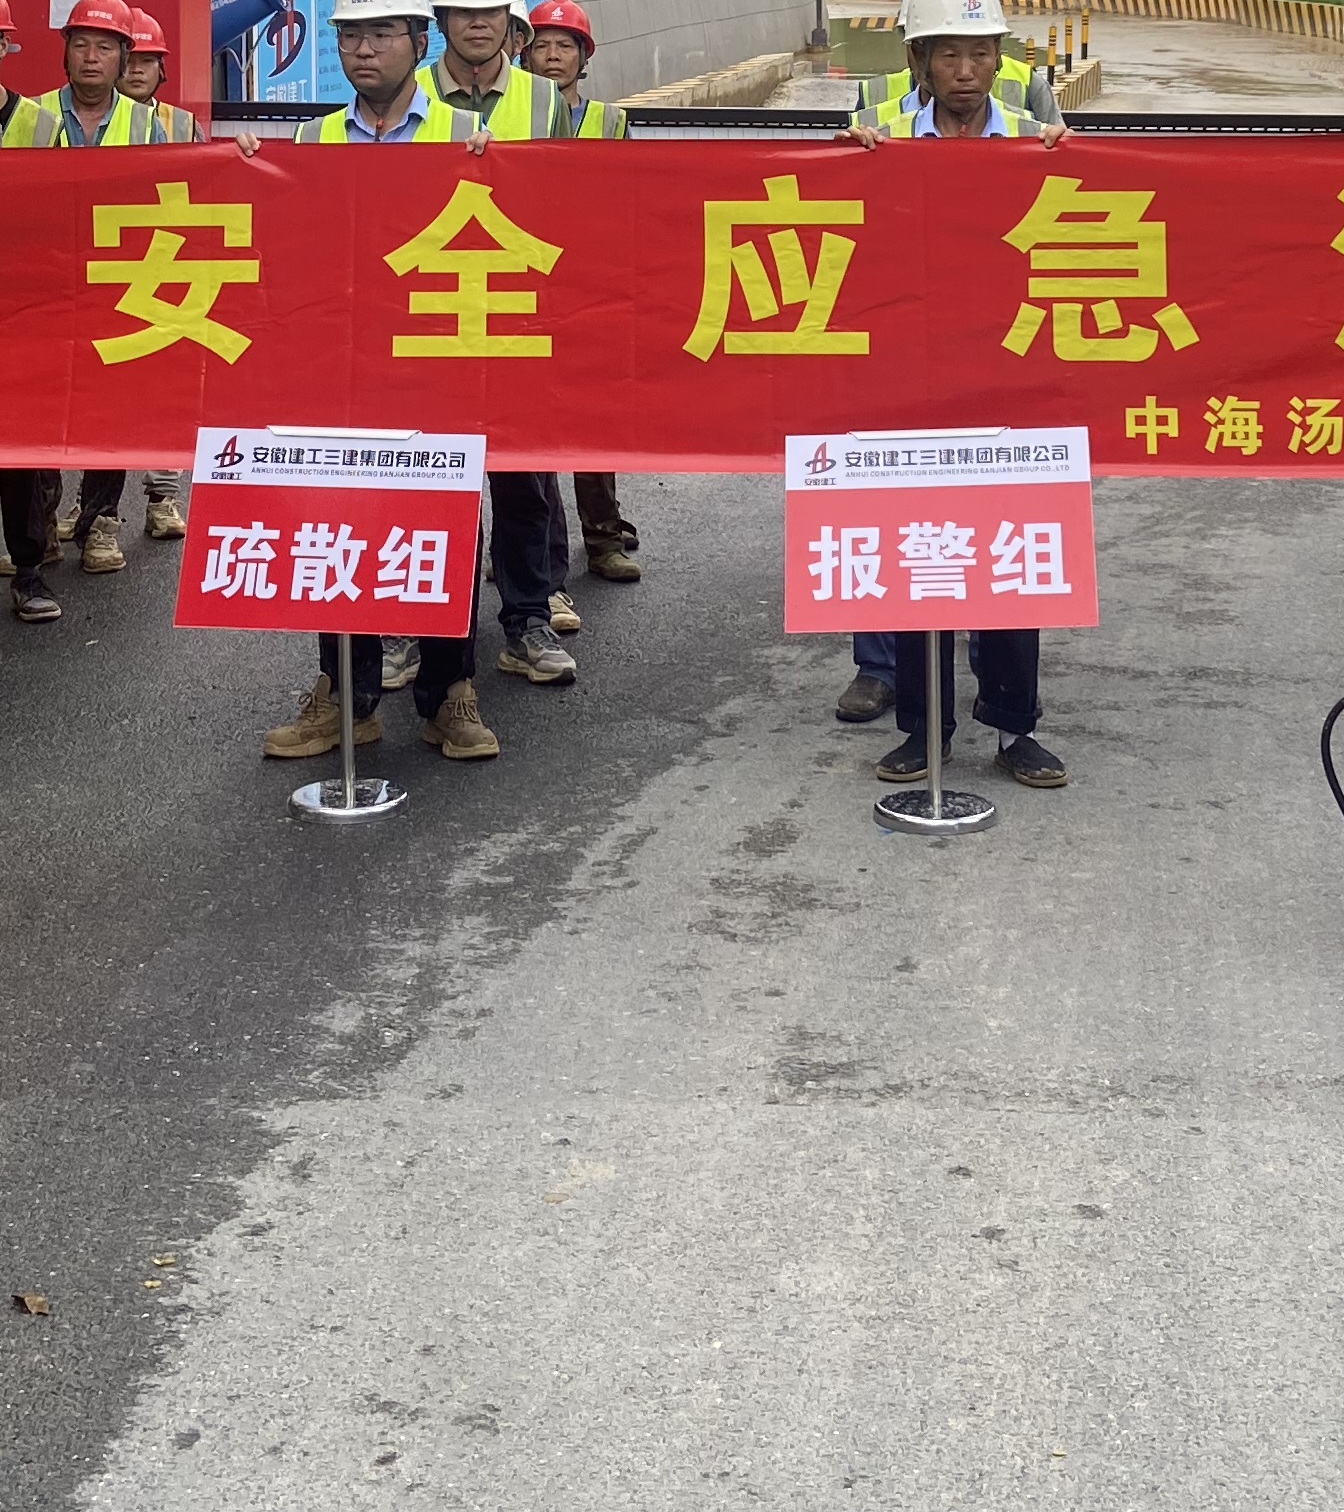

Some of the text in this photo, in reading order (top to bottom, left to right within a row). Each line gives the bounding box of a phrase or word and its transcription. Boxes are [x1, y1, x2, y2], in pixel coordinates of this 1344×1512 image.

[252, 446, 466, 469] 安徽建工三建集团有限公司
[844, 444, 1069, 467] 安徽建工三建集团有限公司
[201, 521, 450, 603] 疏散组
[808, 520, 1072, 601] 报警组
